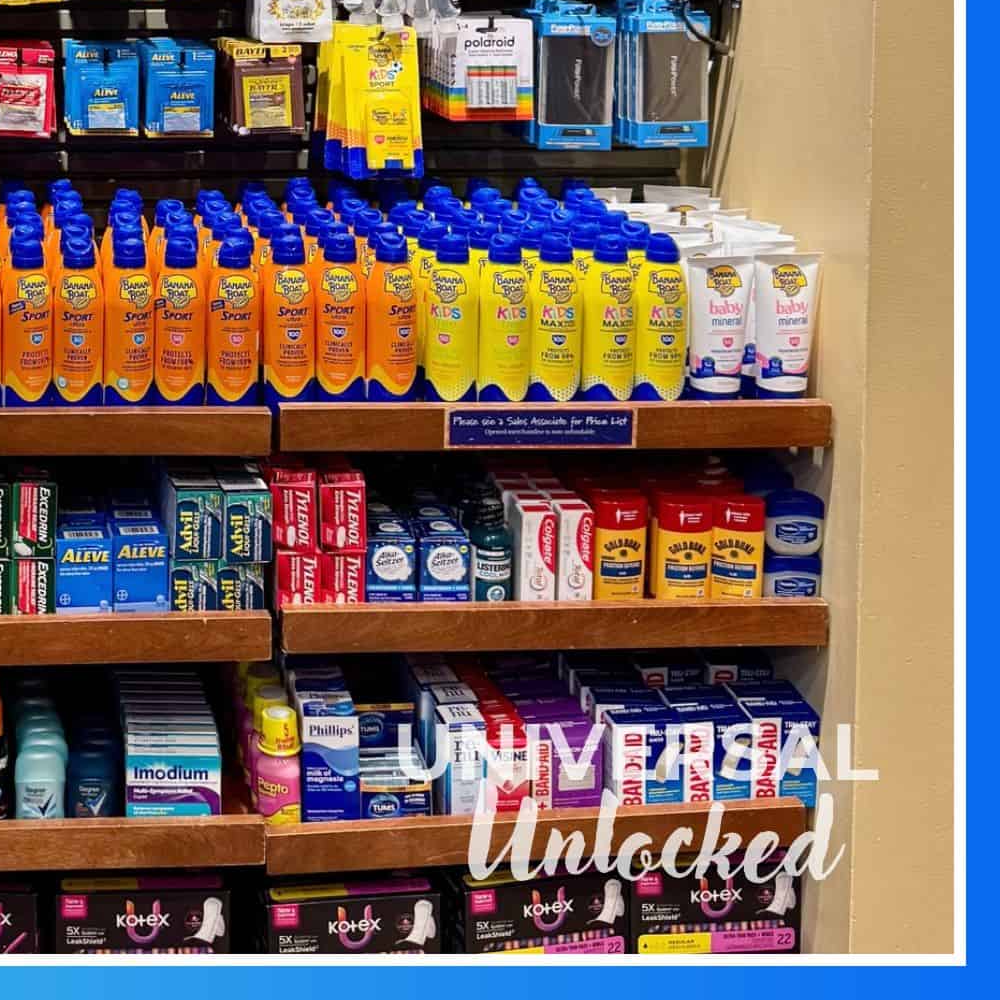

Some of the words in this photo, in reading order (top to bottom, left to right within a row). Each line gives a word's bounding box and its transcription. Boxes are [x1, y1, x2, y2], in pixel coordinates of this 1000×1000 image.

[464, 36, 515, 51] polaroid
[277, 306, 310, 317] SPORT
[322, 303, 354, 315] SPORT
[431, 305, 462, 320] KIDS
[651, 306, 682, 320] KIDS
[708, 299, 743, 316] baby
[711, 316, 742, 327] mineral
[453, 416, 479, 426] Please
[506, 416, 528, 426] Sales
[571, 417, 583, 429] for
[586, 416, 608, 426] Price
[610, 416, 628, 426] List
[295, 489, 311, 547] TYLENOL
[179, 511, 193, 554] Advil
[581, 515, 593, 563] Colgate
[543, 518, 555, 566] Colgate
[61, 548, 110, 564] ALEVE
[134, 765, 209, 781] Imodium
[258, 776, 288, 794] Pepto
[372, 802, 396, 812] TUMS
[641, 903, 655, 912] 5X
[476, 921, 489, 931] 5X
[777, 932, 792, 945] 22
[608, 942, 622, 953] 22
